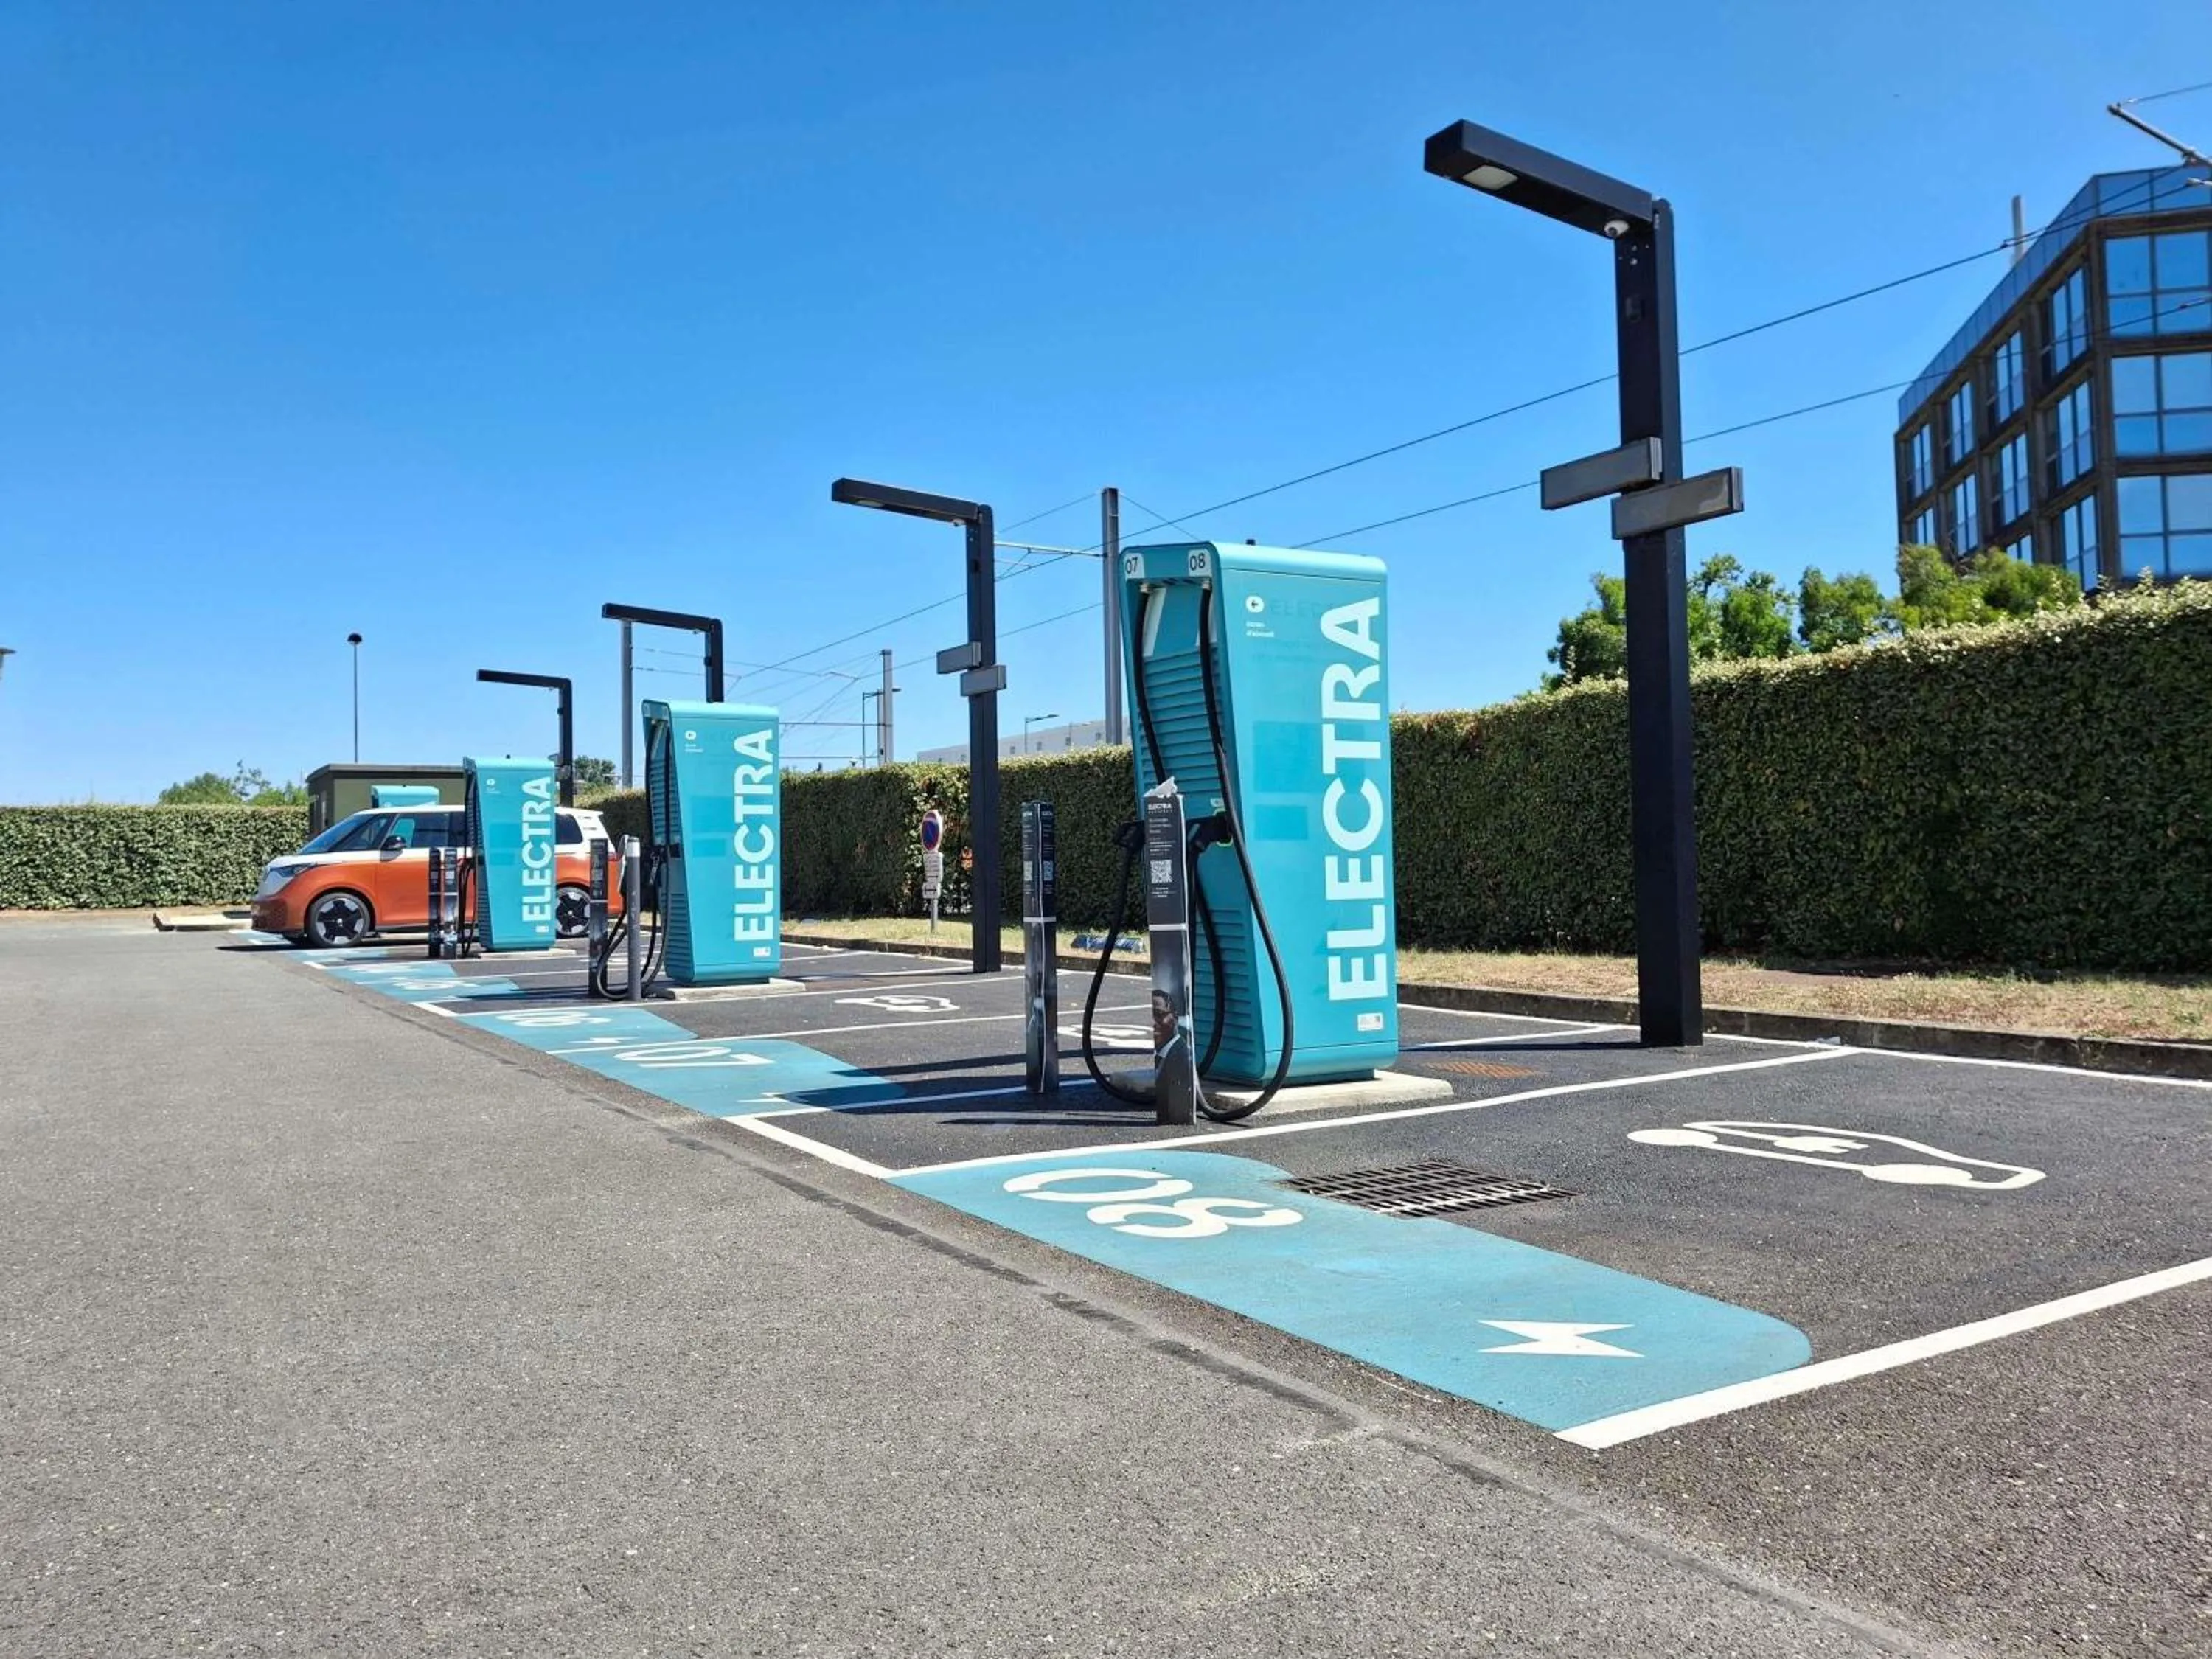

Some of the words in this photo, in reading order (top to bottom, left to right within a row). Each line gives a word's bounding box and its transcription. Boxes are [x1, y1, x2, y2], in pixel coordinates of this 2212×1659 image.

[1125, 557, 1138, 574] 07
[1189, 553, 1206, 571] 08
[522, 777, 552, 922] ELECTRA
[734, 730, 774, 940] ELECTRA
[1321, 597, 1388, 1000] ELECTRA
[1003, 1168, 1304, 1238] 08
